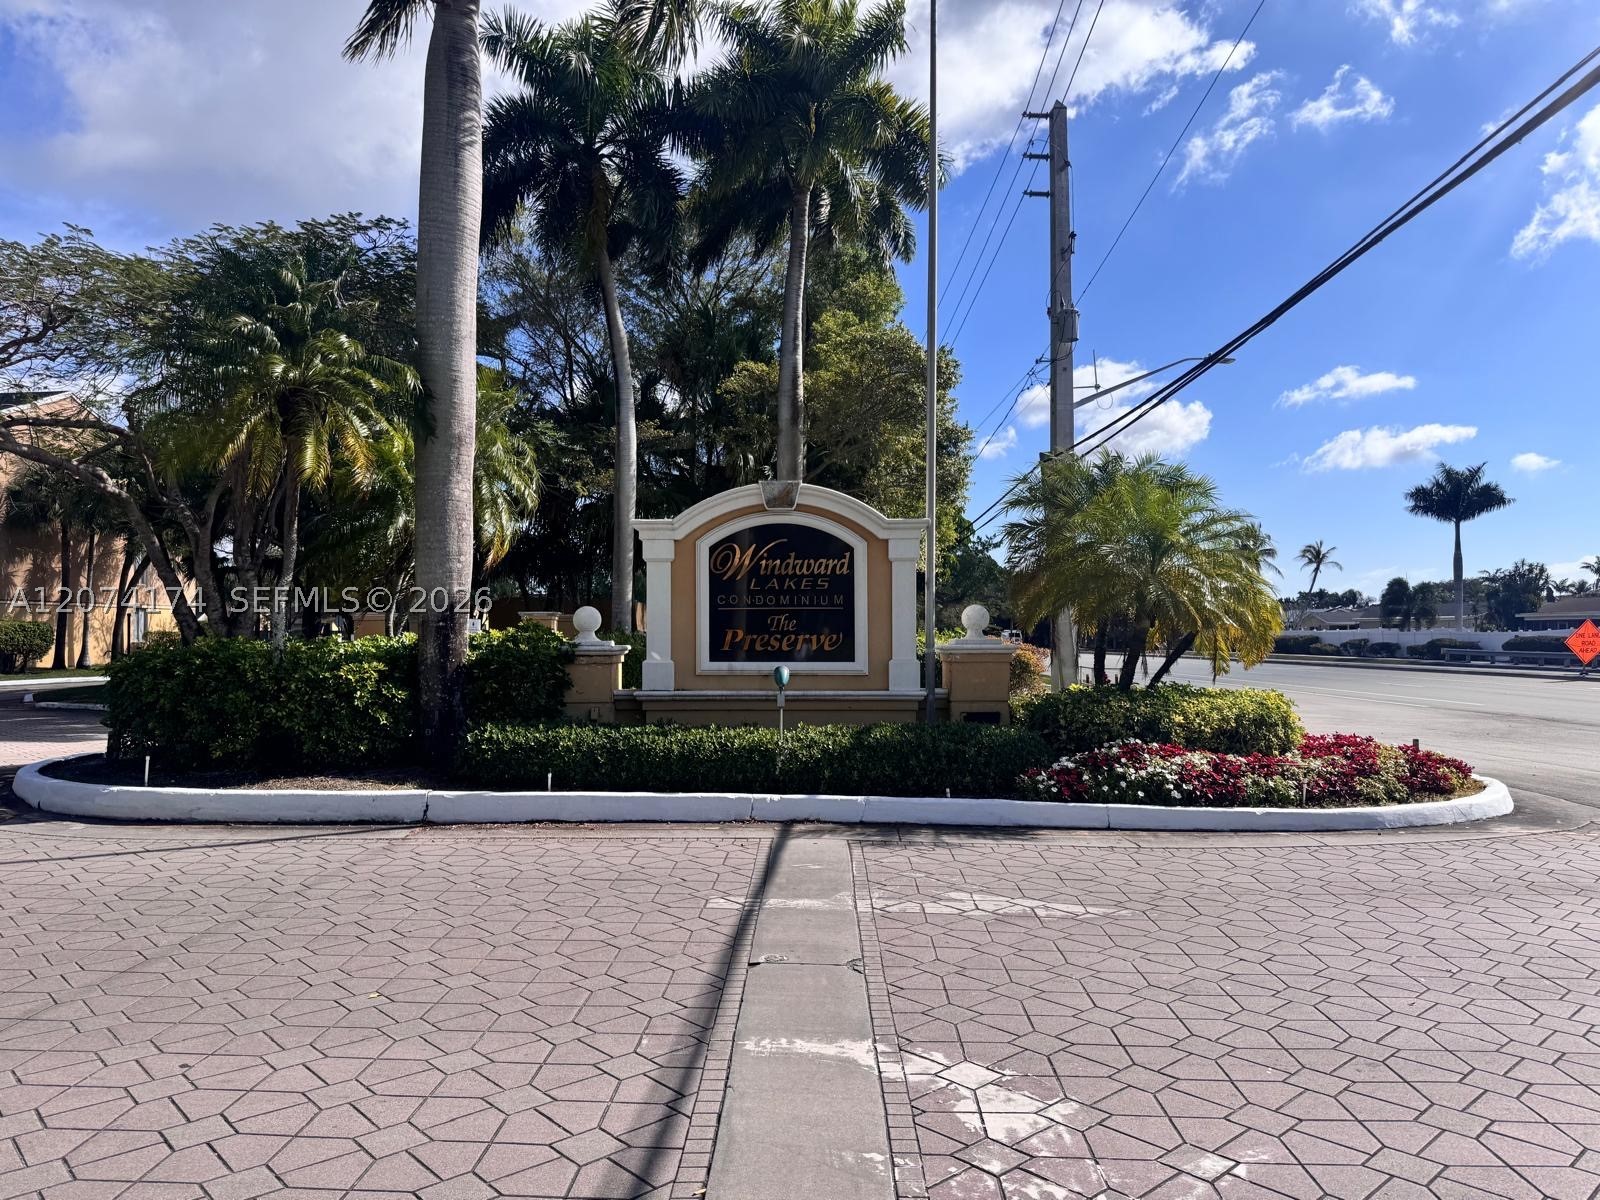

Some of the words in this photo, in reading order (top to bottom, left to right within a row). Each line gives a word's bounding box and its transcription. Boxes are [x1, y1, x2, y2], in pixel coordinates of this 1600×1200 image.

[710, 538, 851, 581] Windward
[750, 577, 830, 590] LAKES
[717, 594, 844, 605] CONDOMINIUM
[767, 613, 797, 631] The
[720, 628, 843, 651] Preserve
